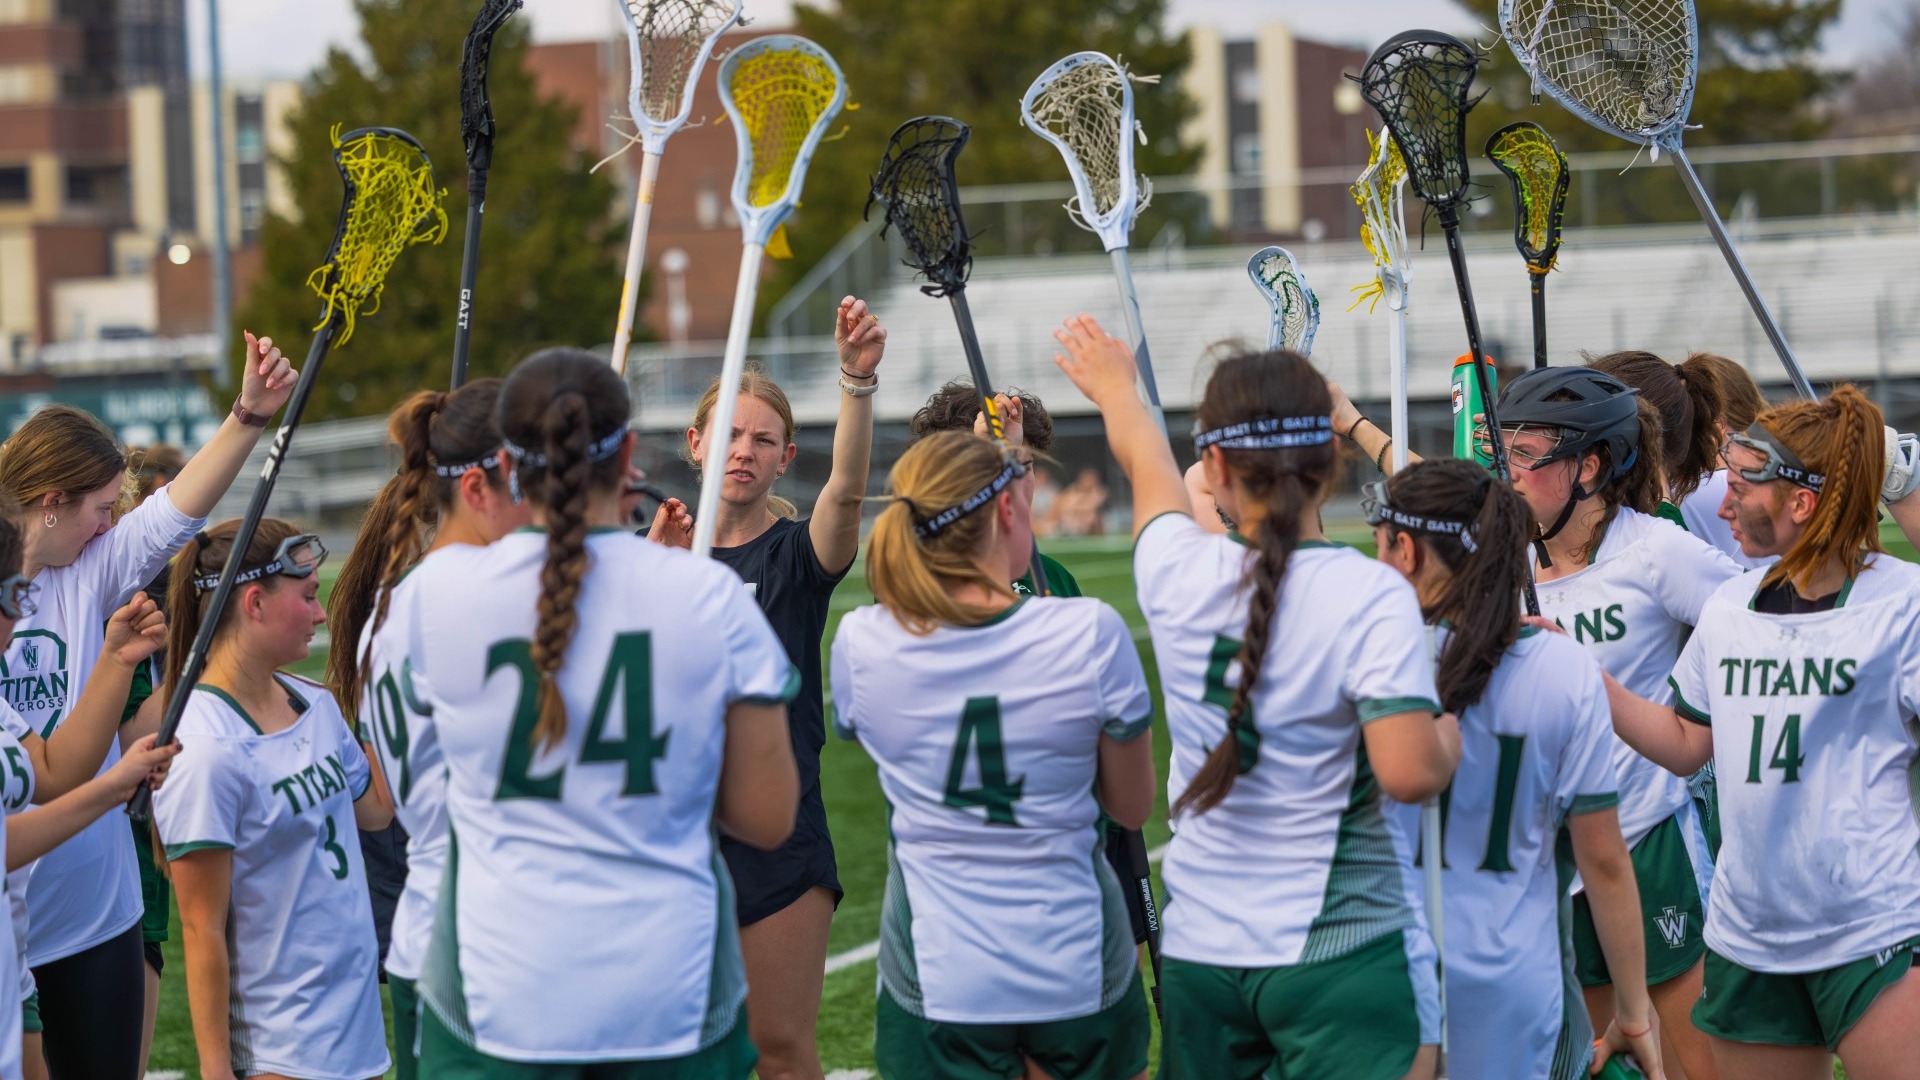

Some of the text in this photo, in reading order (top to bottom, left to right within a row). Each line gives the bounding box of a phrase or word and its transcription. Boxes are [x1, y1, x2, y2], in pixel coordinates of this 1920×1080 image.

[458, 288, 471, 330] GAIT
[1779, 466, 1803, 480] AIT
[1394, 511, 1423, 529] GAIT
[1426, 519, 1463, 534] GAIT
[265, 560, 282, 574] GA
[0, 670, 68, 703] TITAN
[1718, 657, 1858, 697] TITANS
[11, 697, 68, 713] CROSS
[484, 630, 672, 802] 24
[944, 695, 1027, 827] 4
[1745, 713, 1806, 785] 14
[271, 749, 348, 816] TITAN
[323, 813, 350, 881] 3
[1145, 902, 1159, 932] 6700M
